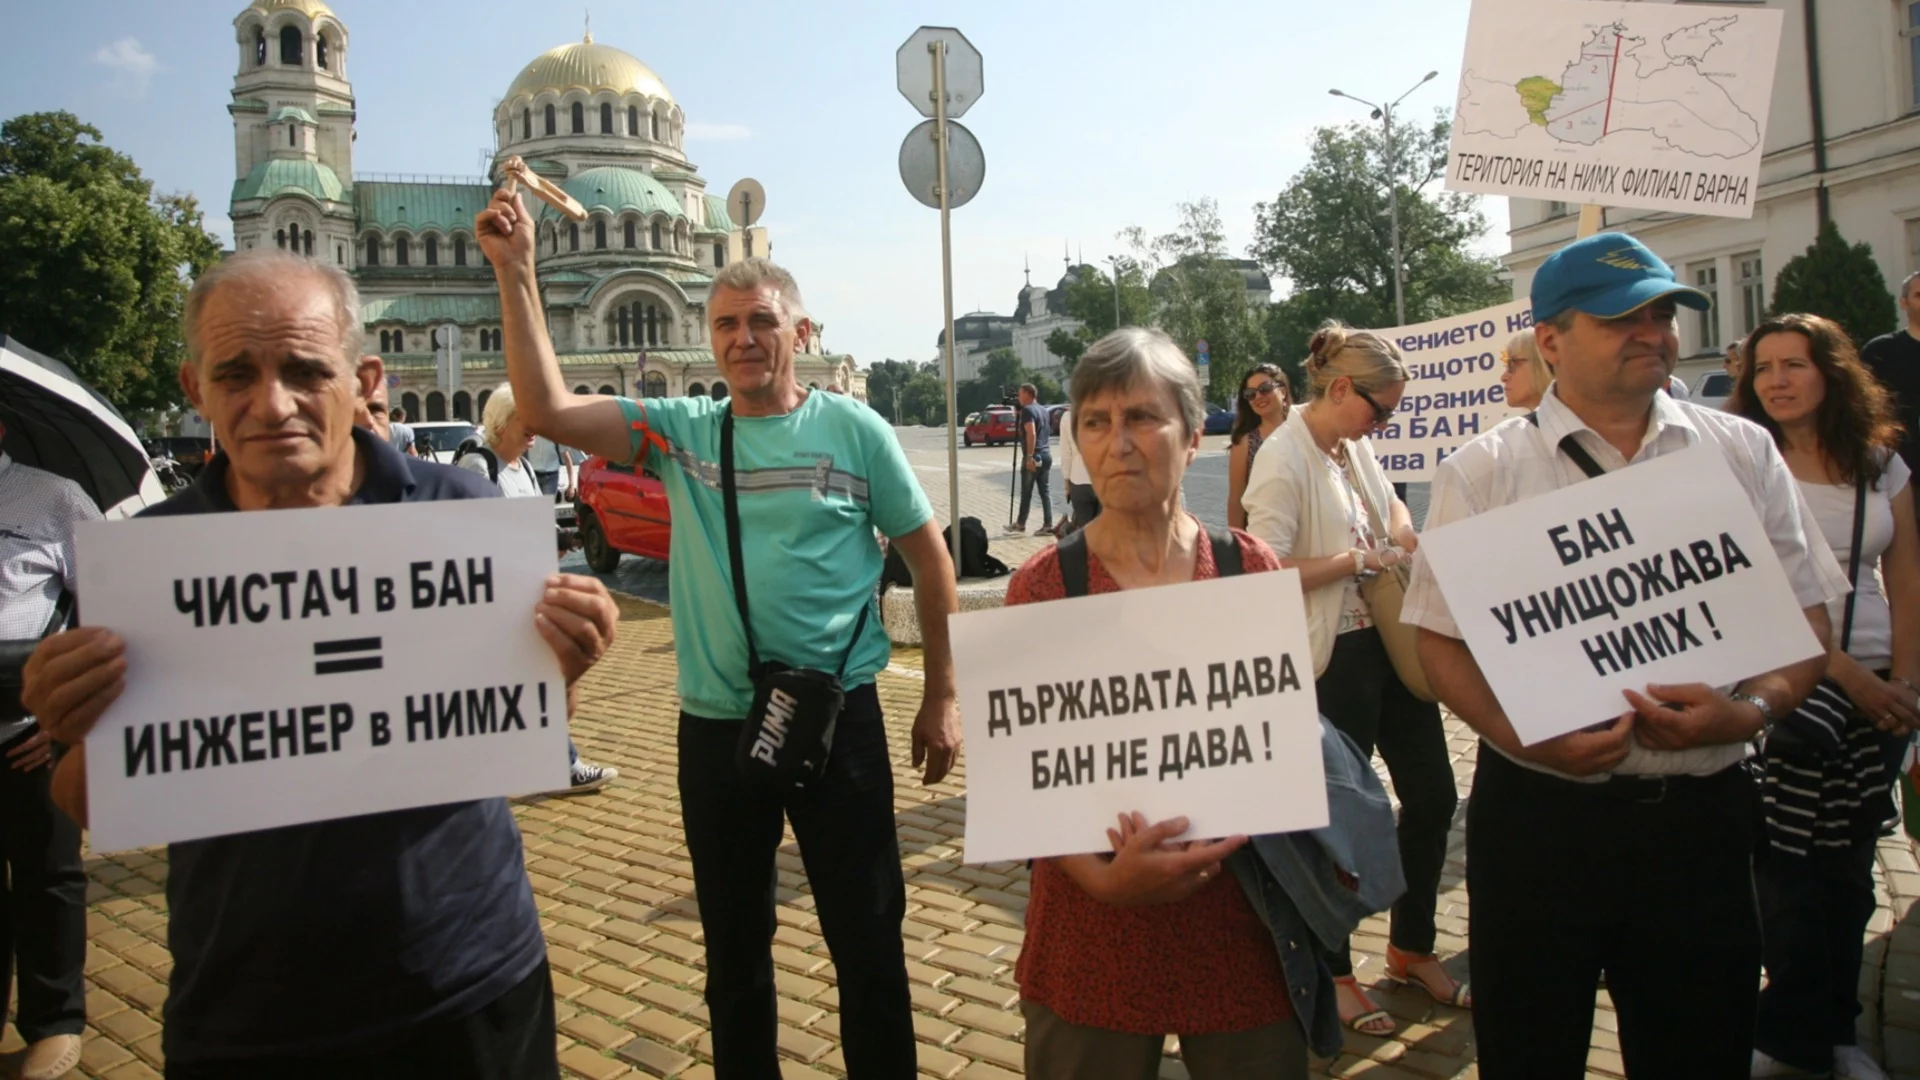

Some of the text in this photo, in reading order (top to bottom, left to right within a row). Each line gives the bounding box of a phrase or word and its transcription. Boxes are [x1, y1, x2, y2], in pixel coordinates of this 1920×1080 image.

[1456, 153, 1749, 206] ТЕРИТОРИЯ НА НИМХ ФИЛИАЛ ВАРНА
[1409, 413, 1479, 439] БАН
[1547, 508, 1634, 566] БАН
[174, 557, 494, 628] ЧИСТАЧ в БАН
[1490, 532, 1752, 644] УНИЩОЖАВА
[1580, 607, 1703, 677] НИМХ
[750, 688, 798, 767] PUMA
[988, 653, 1301, 738] ДЪРЖАВАТА ДАВА
[124, 703, 354, 778] ИНЖЕНЕР
[371, 711, 391, 746] в
[405, 684, 526, 743] НИМХ
[1031, 744, 1095, 790] БАН
[1107, 738, 1148, 781] НЕ
[1159, 724, 1253, 782] ДАВА
